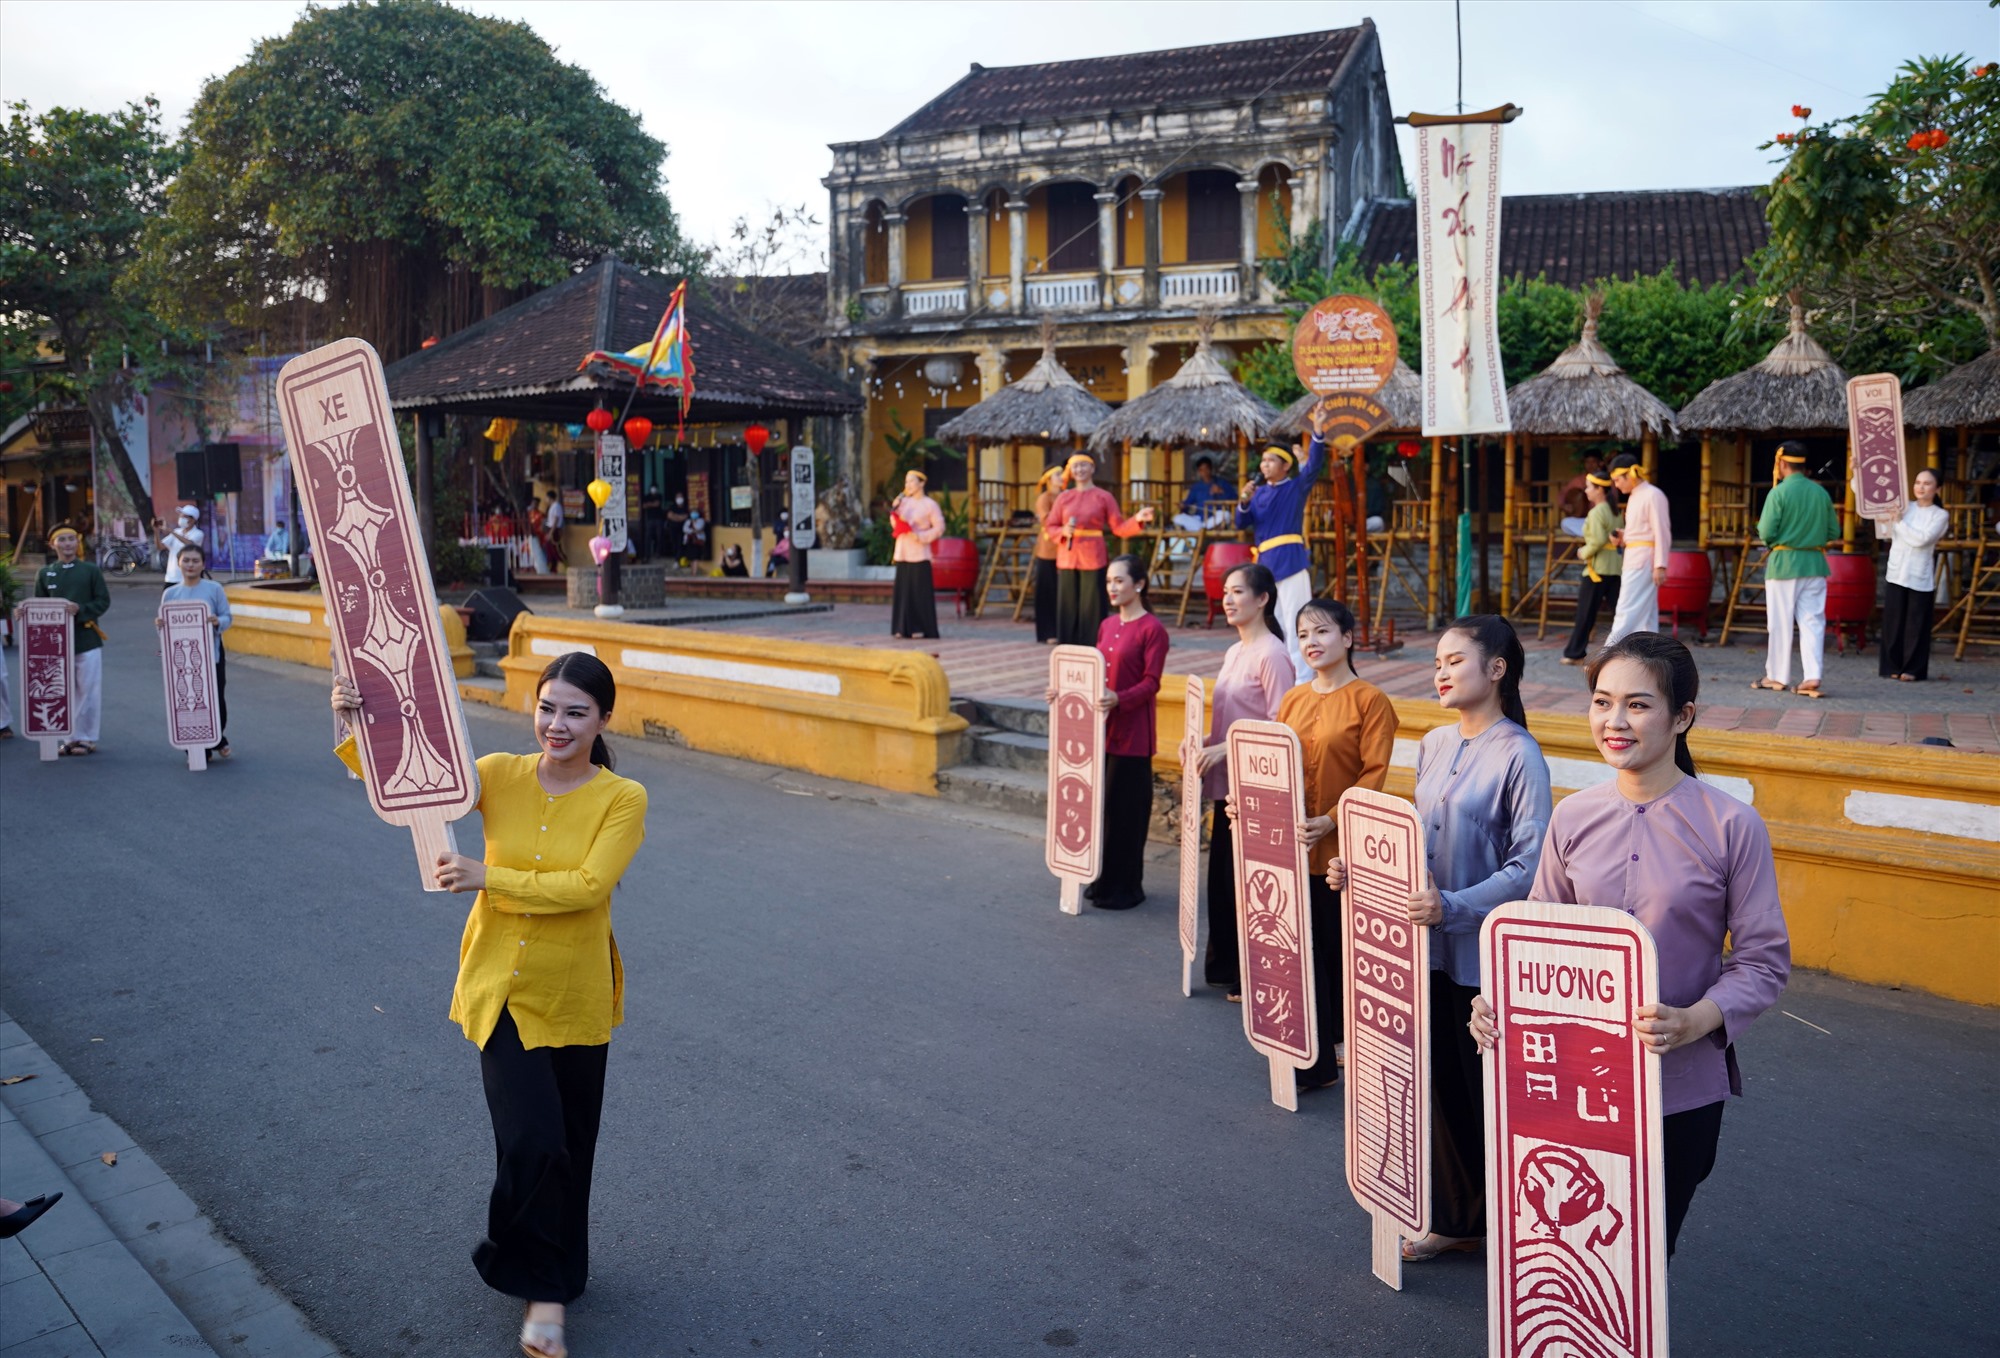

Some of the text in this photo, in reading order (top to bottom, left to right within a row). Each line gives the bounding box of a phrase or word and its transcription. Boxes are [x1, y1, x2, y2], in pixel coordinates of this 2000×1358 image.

[318, 392, 348, 426] XE
[1066, 669, 1086, 685] HAI
[1248, 752, 1279, 777] NGỦ
[1364, 833, 1398, 867] GỐI
[1517, 960, 1616, 1004] HƯƠNG
